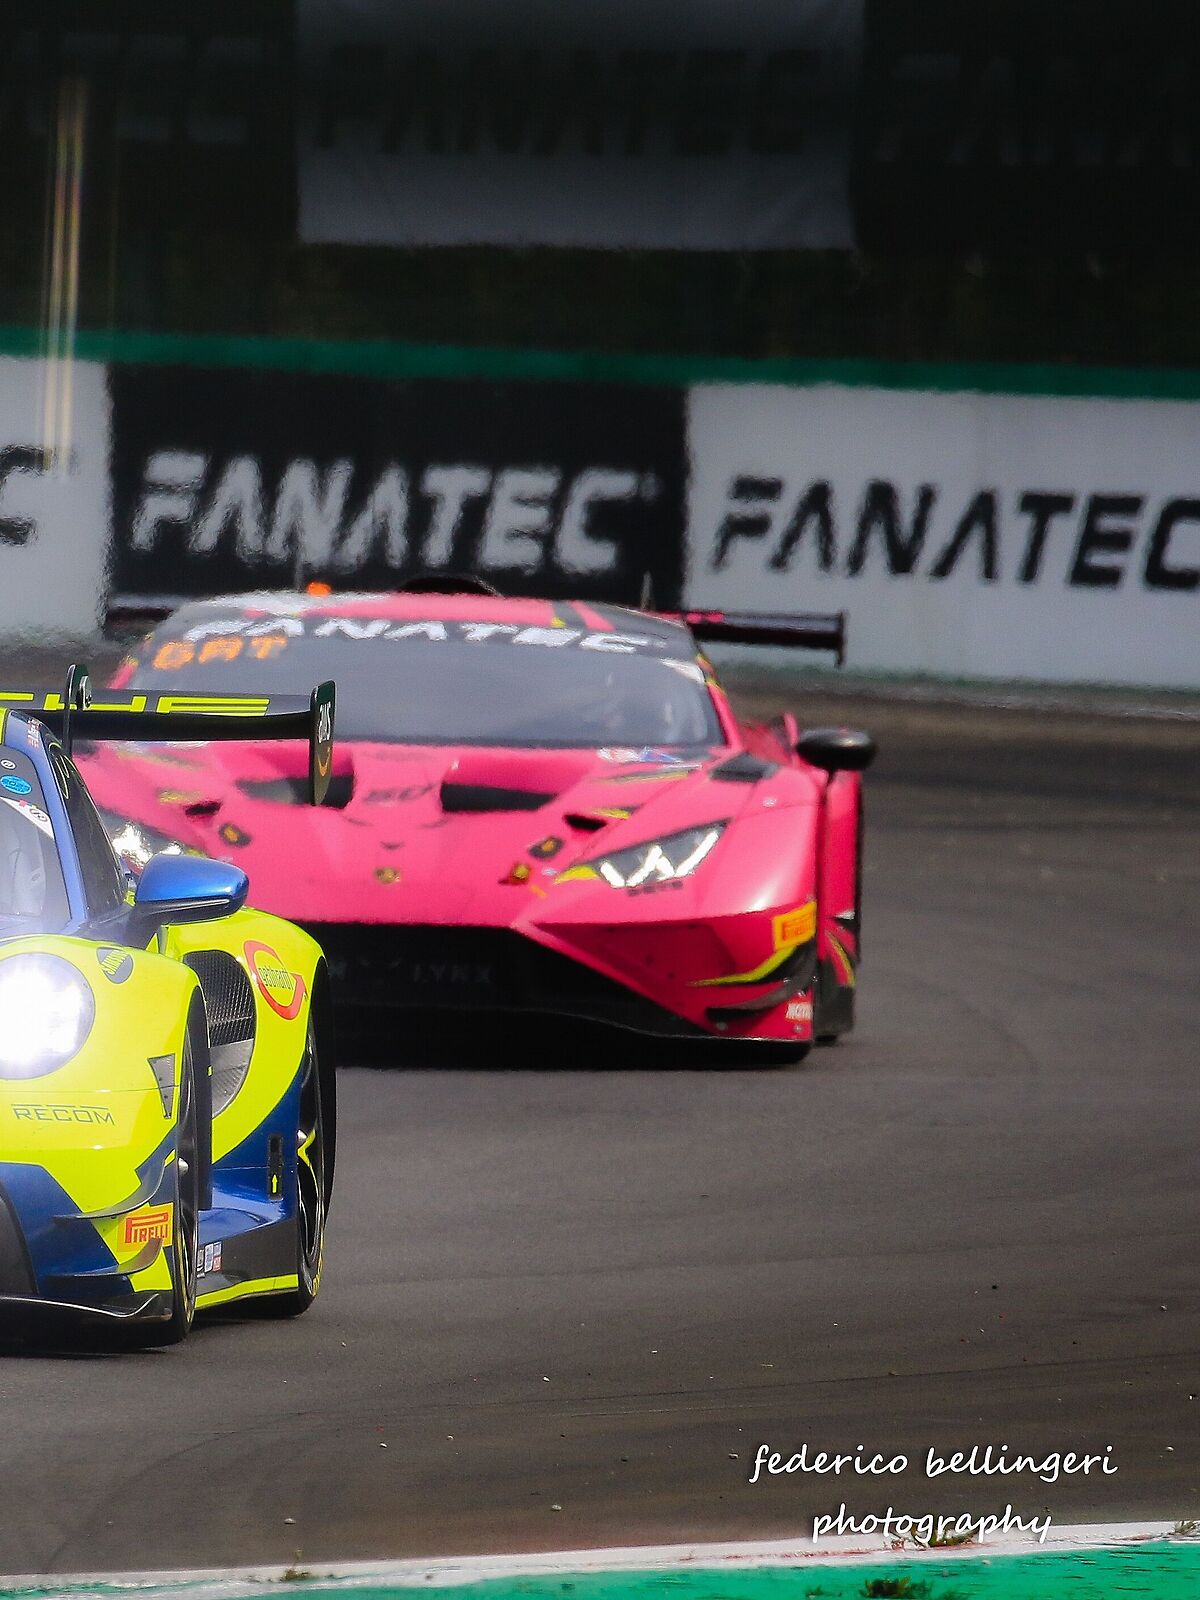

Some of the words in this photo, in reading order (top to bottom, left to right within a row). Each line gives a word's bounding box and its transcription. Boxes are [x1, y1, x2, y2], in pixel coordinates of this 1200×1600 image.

[130, 448, 640, 577] FANATEC
[712, 474, 1200, 590] FANATEC
[182, 616, 650, 654] FANATEC
[11, 1104, 116, 1126] RECOM
[124, 1211, 169, 1245] PIRELLI
